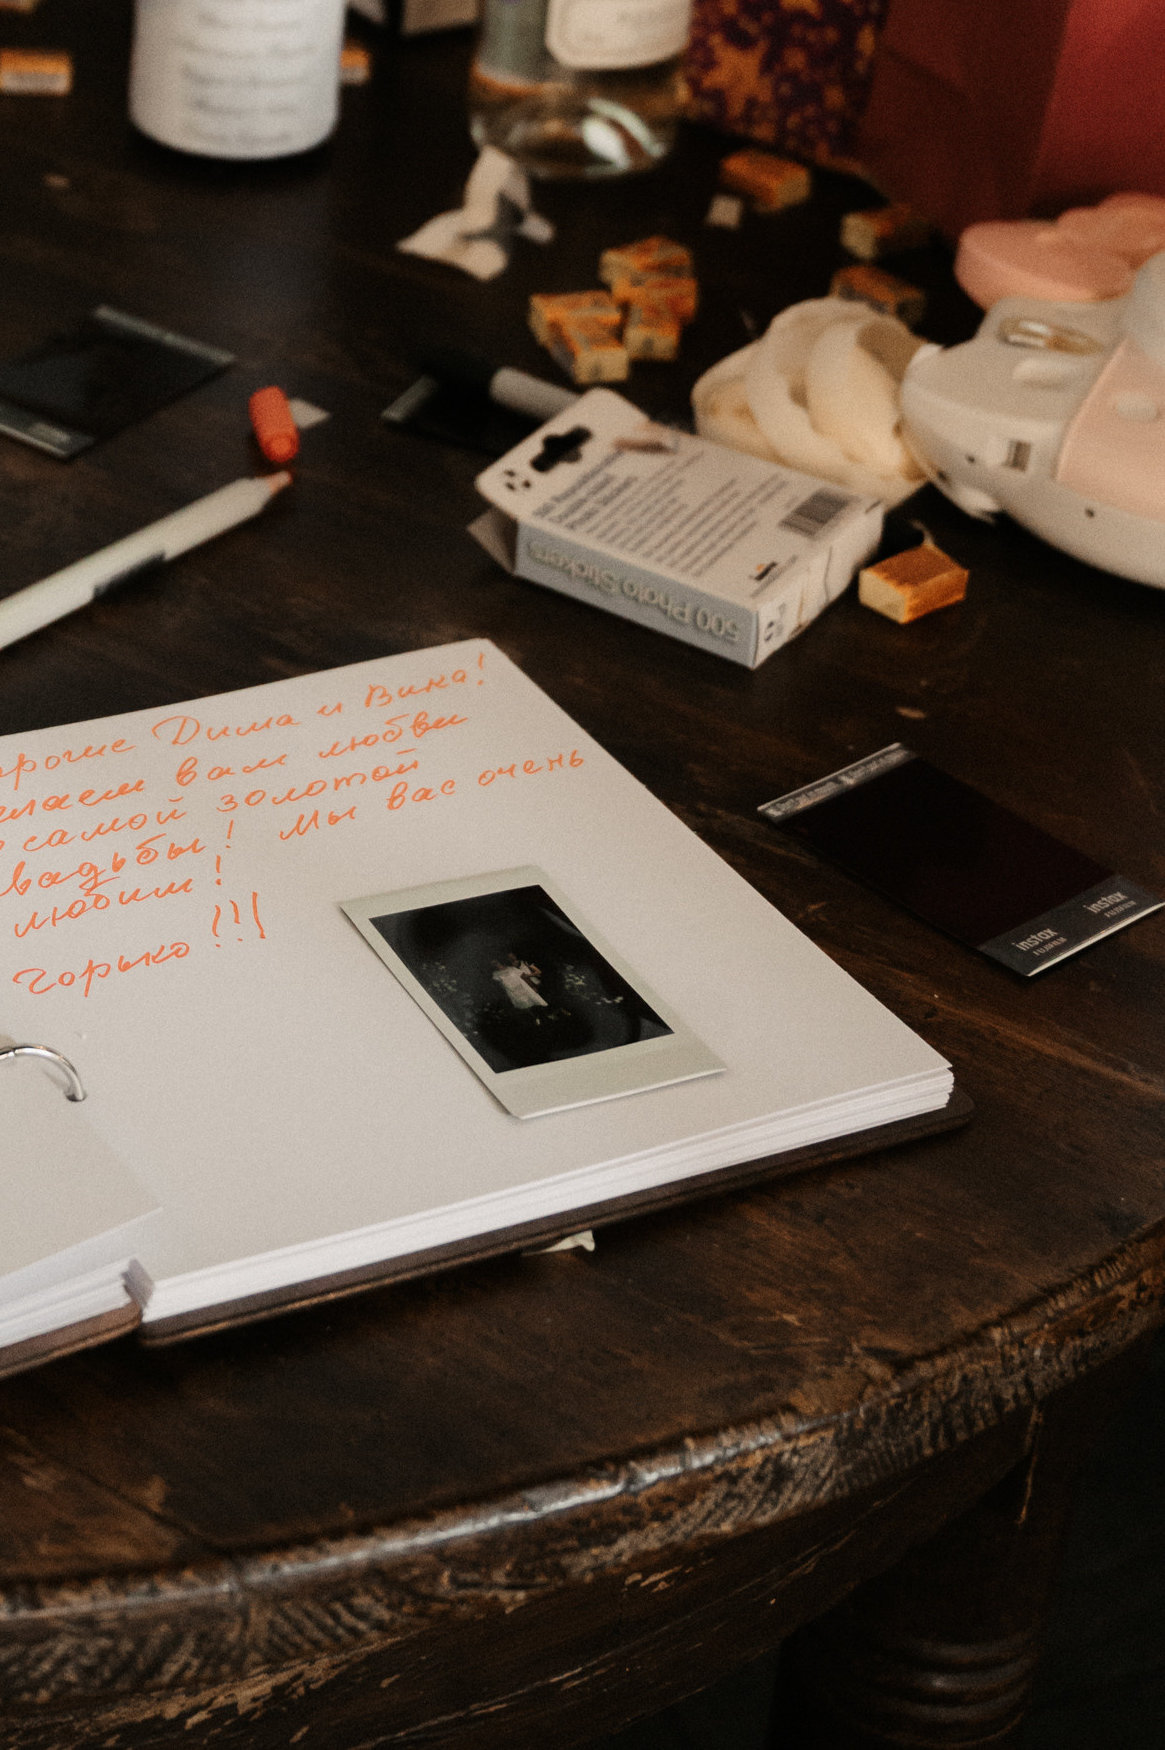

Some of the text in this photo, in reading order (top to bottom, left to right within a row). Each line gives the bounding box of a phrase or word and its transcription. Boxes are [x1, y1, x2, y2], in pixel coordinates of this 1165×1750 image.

[619, 576, 690, 627] Photo
[691, 603, 740, 643] 500
[151, 714, 301, 746] Дима
[317, 702, 343, 717] и
[364, 653, 484, 708] Вика!
[175, 756, 288, 787] вам
[318, 710, 468, 759] любви
[22, 796, 187, 852] самой
[216, 747, 419, 812] золотой
[279, 805, 357, 841] Мы
[386, 781, 456, 810] вас
[478, 749, 585, 787] очень
[1083, 891, 1129, 914] instax
[1012, 928, 1058, 951] instax
